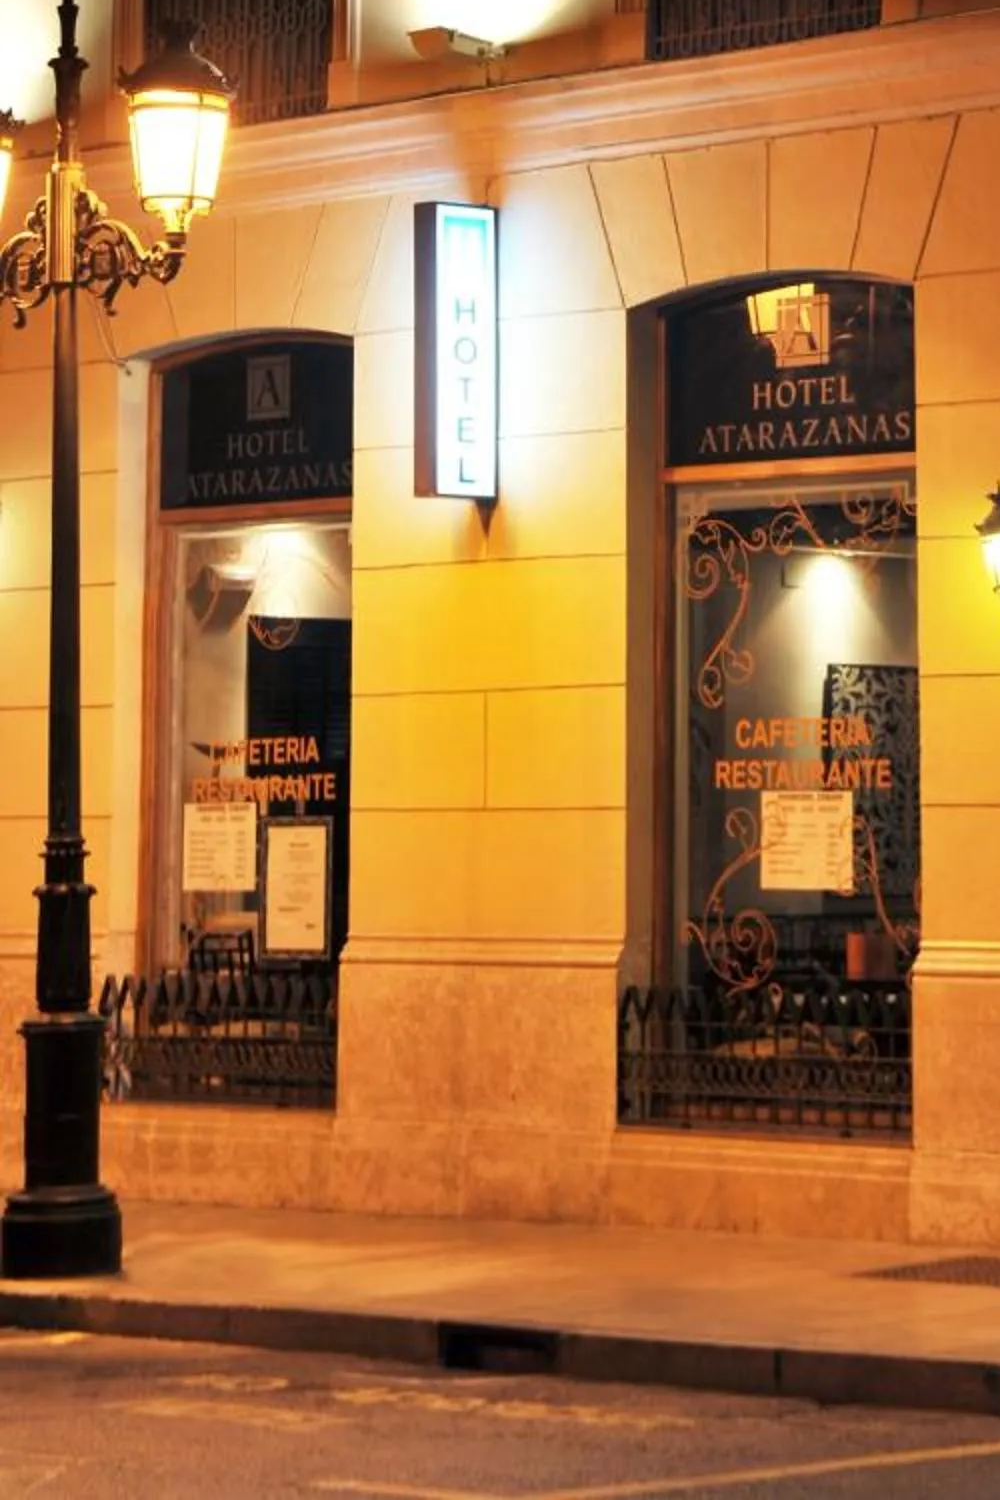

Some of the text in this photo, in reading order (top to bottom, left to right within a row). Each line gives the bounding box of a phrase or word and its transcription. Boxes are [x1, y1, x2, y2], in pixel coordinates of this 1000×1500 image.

[454, 297, 478, 485] HOTEL
[751, 375, 856, 411] HOTEL
[225, 427, 311, 460] HOTEL
[699, 410, 912, 454] ATARAZANAS
[734, 716, 873, 749] CAFETERIA
[714, 758, 893, 790] RESTAURANTE
